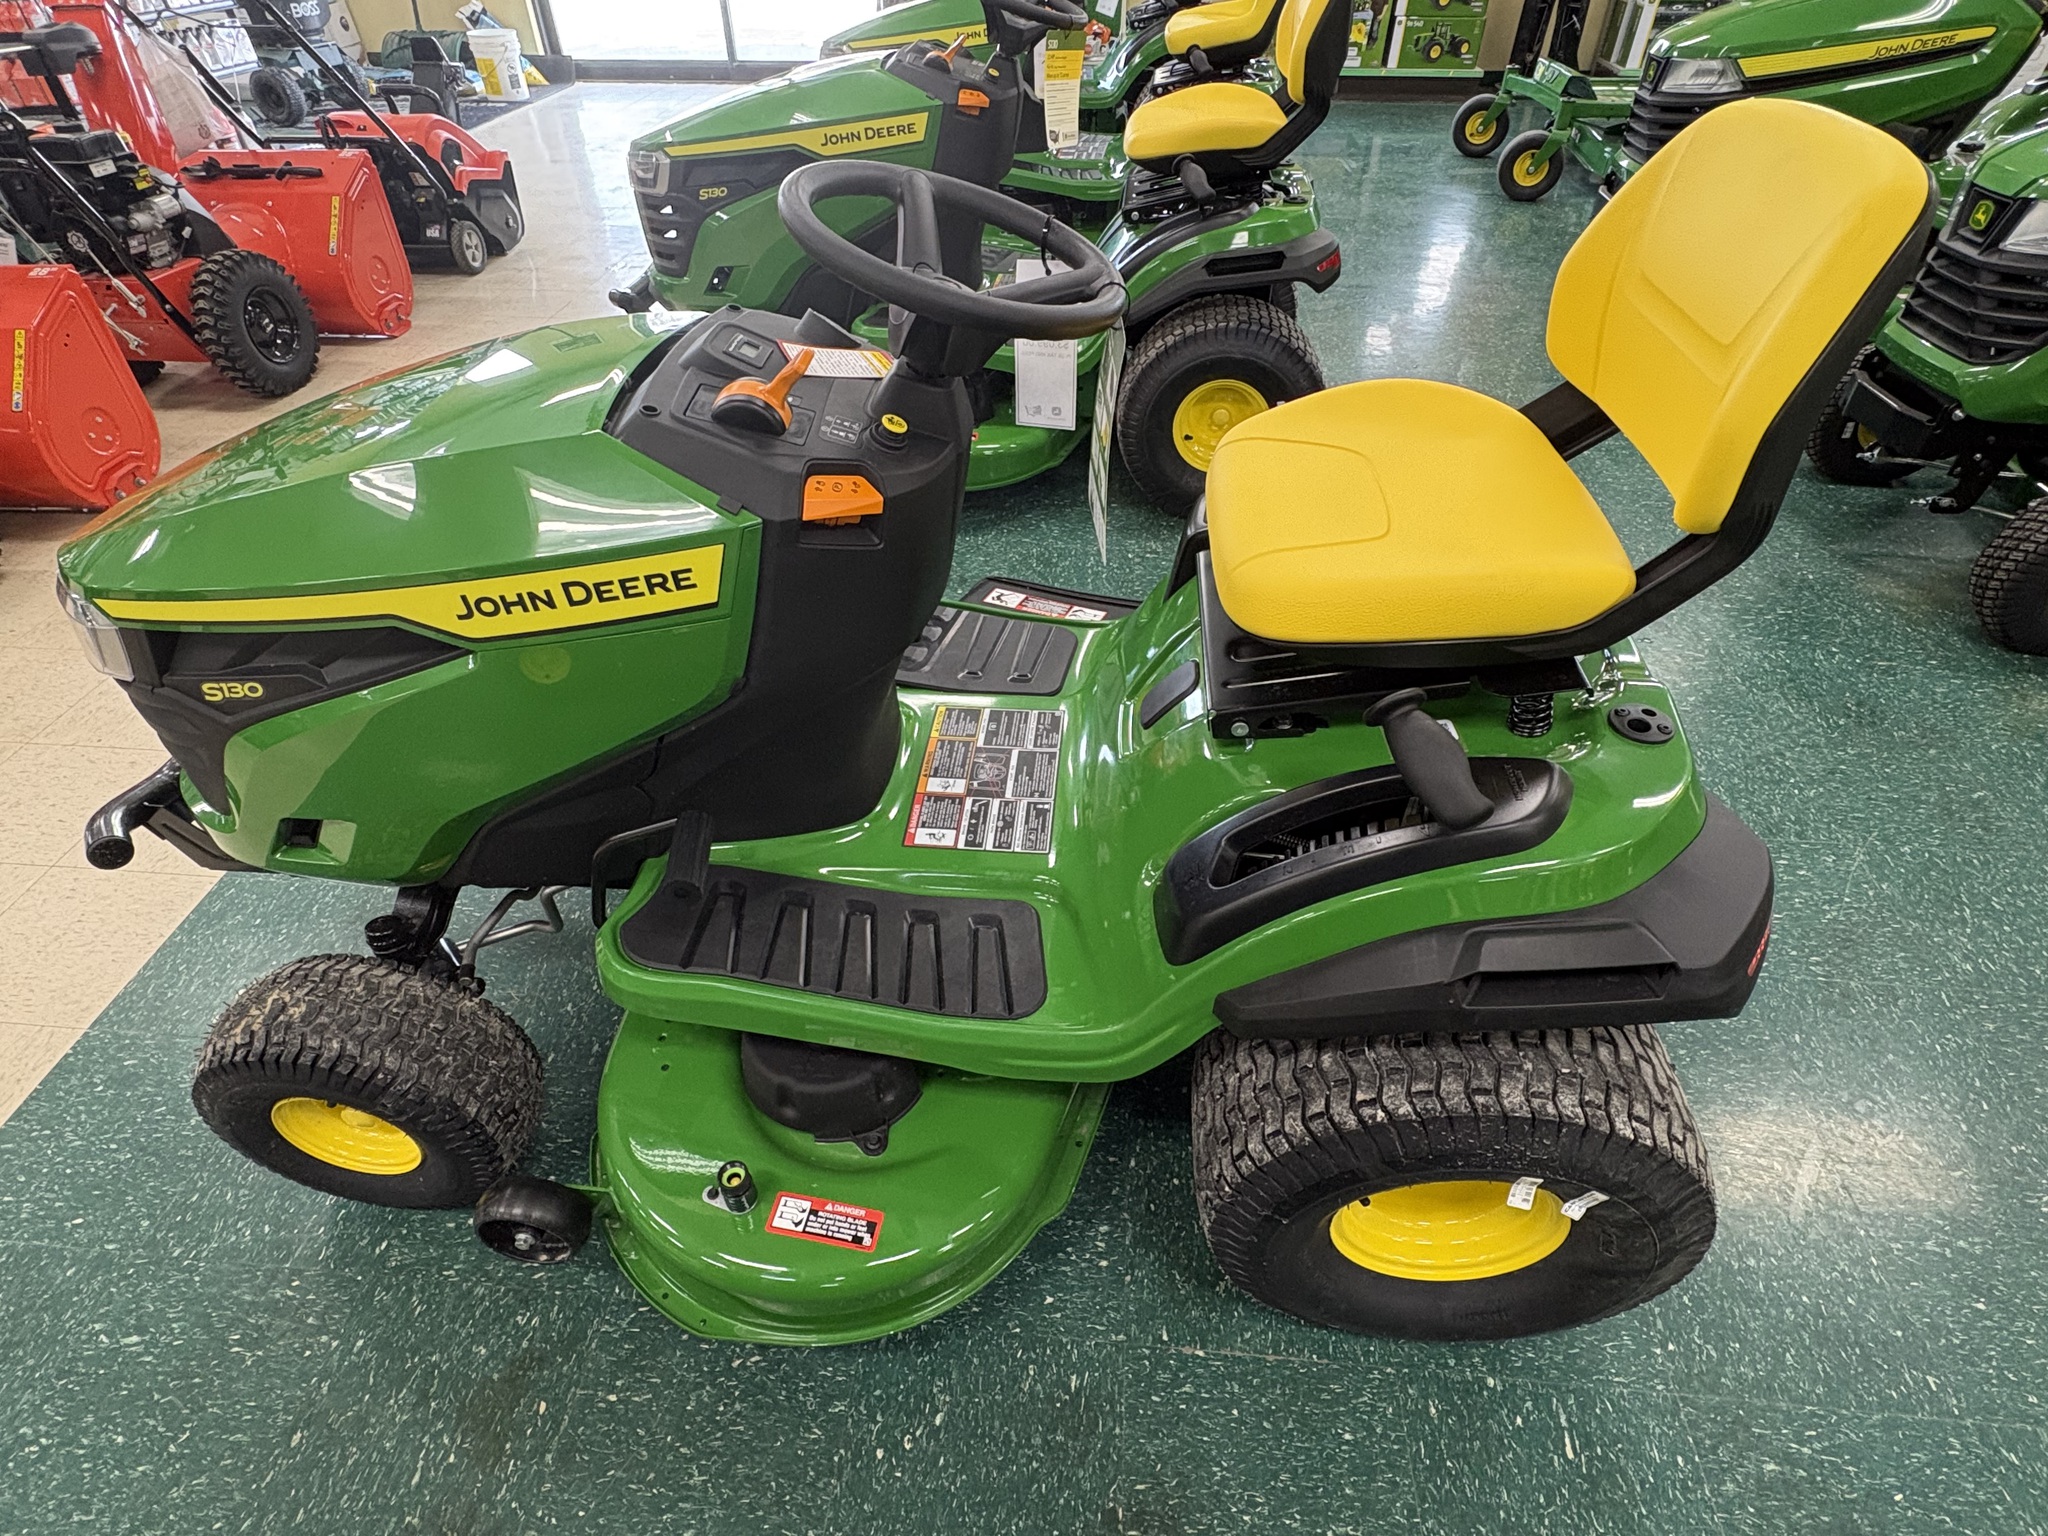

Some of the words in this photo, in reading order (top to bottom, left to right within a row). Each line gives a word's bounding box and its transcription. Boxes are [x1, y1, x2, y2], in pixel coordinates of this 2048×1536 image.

[290, 0, 320, 18] BOSS
[1869, 43, 1910, 59] JOHN
[1910, 34, 1959, 51] DEERE
[821, 131, 861, 147] JOHN
[864, 123, 917, 140] DEERE
[699, 187, 728, 200] S130
[456, 588, 558, 620] JOHN
[561, 568, 698, 607] DEERE
[201, 682, 263, 701] S130
[925, 751, 933, 772] WARNING
[911, 804, 921, 827] DANGER
[818, 1211, 846, 1221] ROTATING
[847, 1216, 867, 1226] BLADE
[833, 1204, 866, 1216] DANGER
